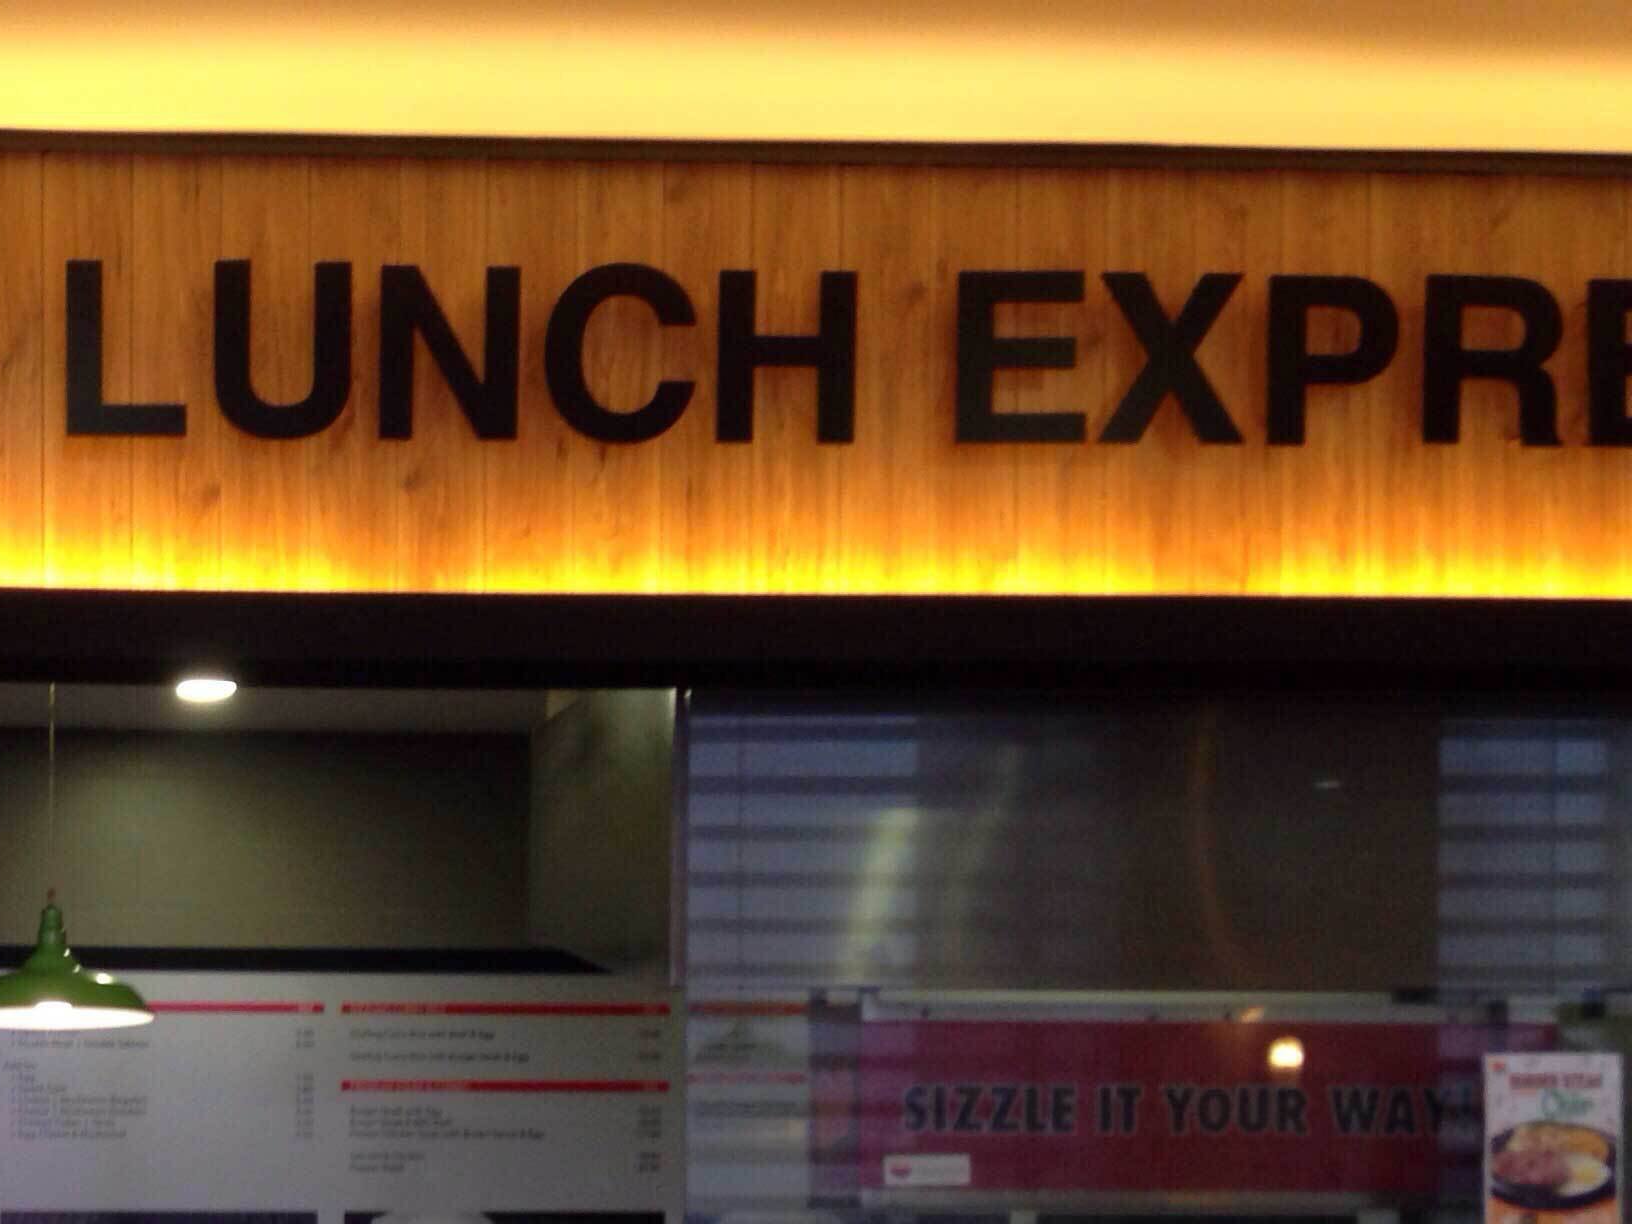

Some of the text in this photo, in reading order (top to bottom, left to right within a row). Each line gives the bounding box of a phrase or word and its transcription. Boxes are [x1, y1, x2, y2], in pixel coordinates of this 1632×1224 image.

[65, 259, 859, 445] LUNCH
[903, 1085, 1078, 1135] SIZZLE
[1096, 1086, 1143, 1134] IT
[1164, 1086, 1310, 1135] YOUR
